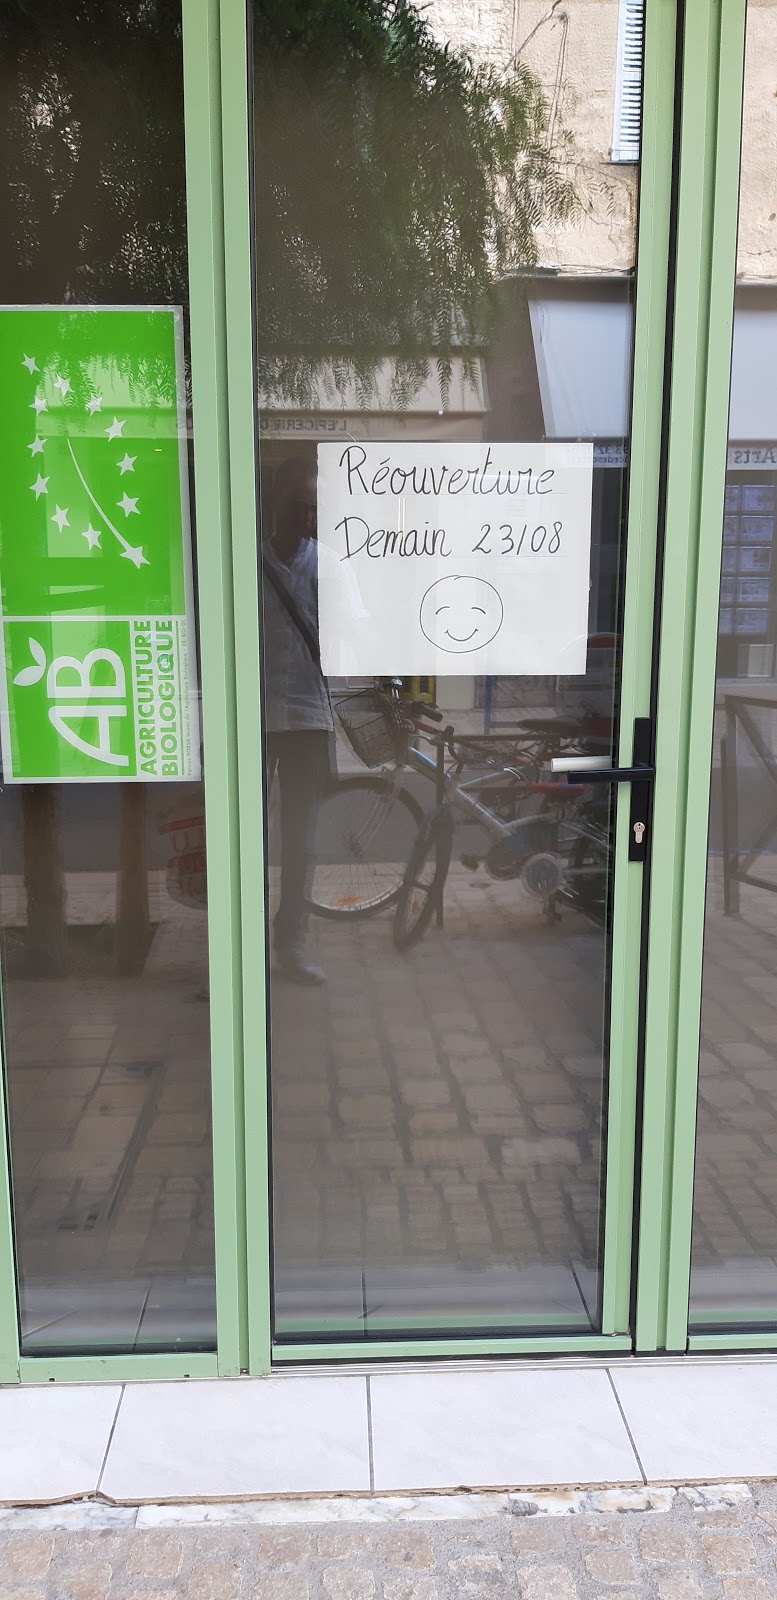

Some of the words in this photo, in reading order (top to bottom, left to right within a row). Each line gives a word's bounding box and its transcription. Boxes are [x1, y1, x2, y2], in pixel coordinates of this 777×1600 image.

[339, 446, 555, 495] Réouverture
[335, 516, 452, 562] Demain
[472, 521, 563, 555] 23/08
[47, 648, 129, 766] AB
[134, 621, 157, 776] AGRICULTURE
[156, 621, 178, 776] BIOLOGIQUE
